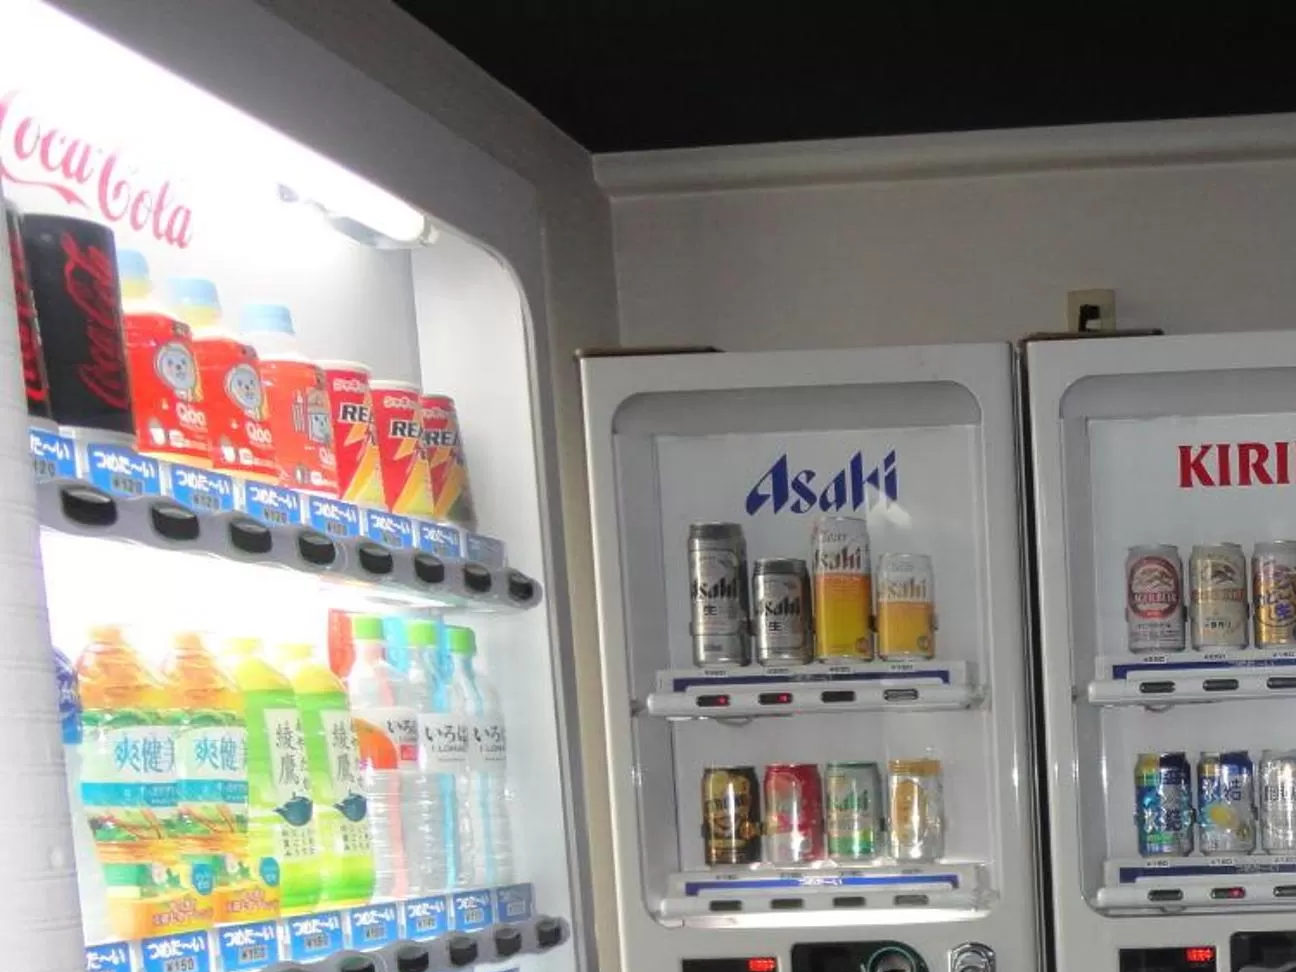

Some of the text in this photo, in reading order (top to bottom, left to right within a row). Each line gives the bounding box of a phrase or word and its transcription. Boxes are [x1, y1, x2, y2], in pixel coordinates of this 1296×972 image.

[745, 449, 898, 516] Asahi
[194, 737, 247, 773] 爽健
[166, 958, 195, 972] ¥150
